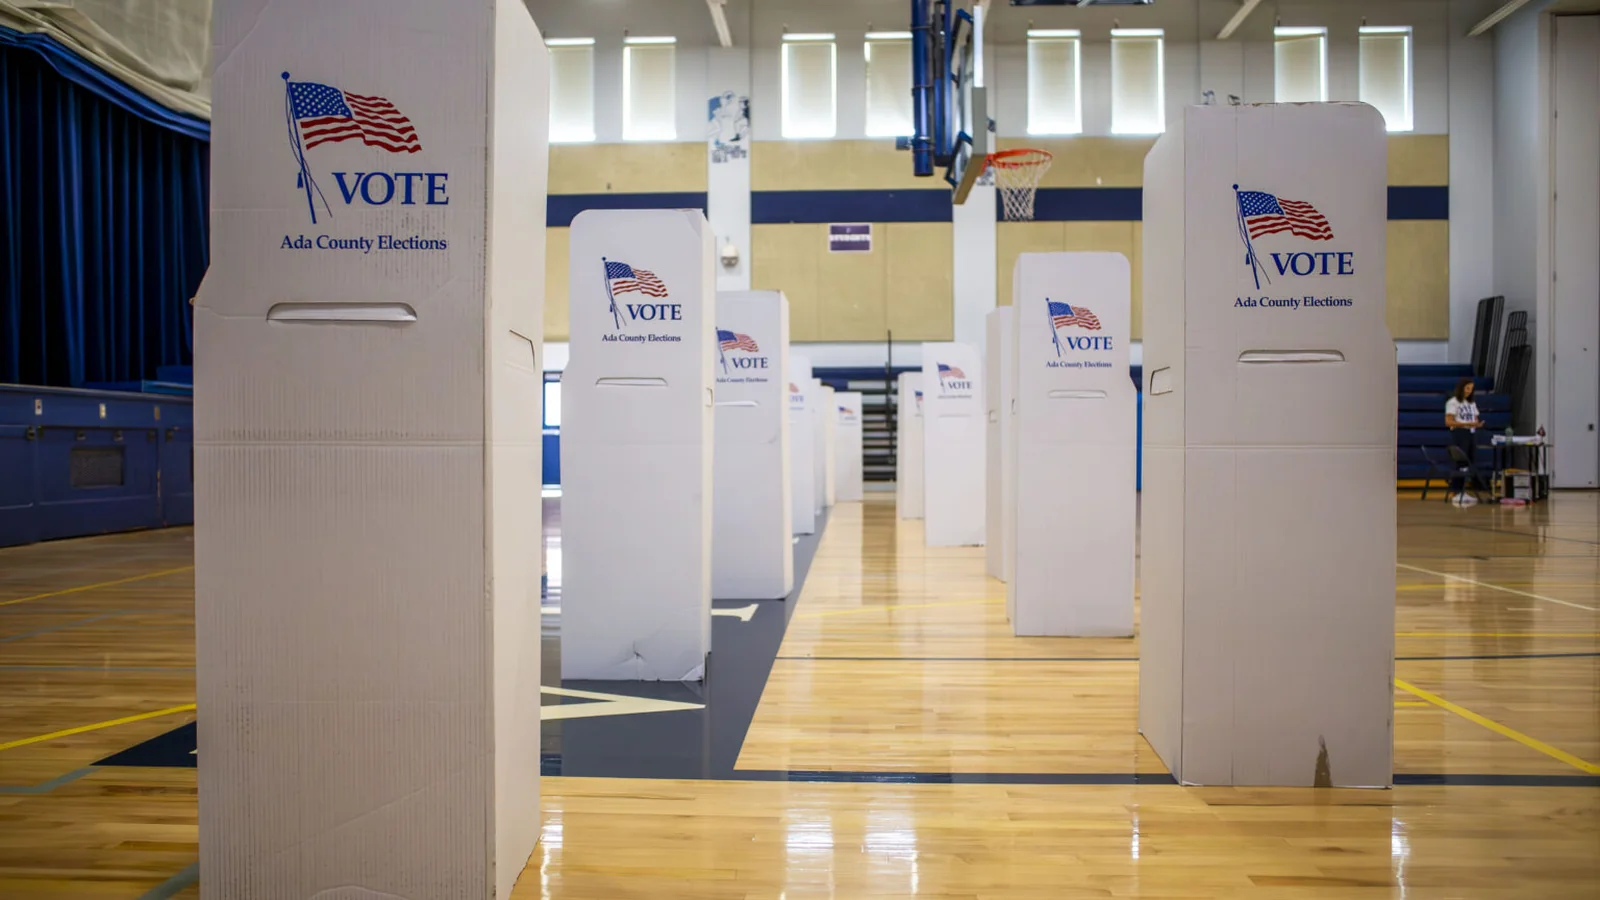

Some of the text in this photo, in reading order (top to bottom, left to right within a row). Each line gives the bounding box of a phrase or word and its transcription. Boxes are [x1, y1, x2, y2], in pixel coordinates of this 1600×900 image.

[331, 171, 450, 206] VOTE
[280, 234, 448, 254] Ada County Elections
[1269, 251, 1355, 276] VOTE
[1234, 295, 1353, 310] Ada County Elections
[626, 303, 682, 321] VOTE
[602, 333, 682, 344] Ada County Elections
[1066, 336, 1114, 351] VOTE
[732, 357, 769, 369] VOTE
[1046, 360, 1113, 369] Ada County Elections
[948, 380, 973, 390] VOTE
